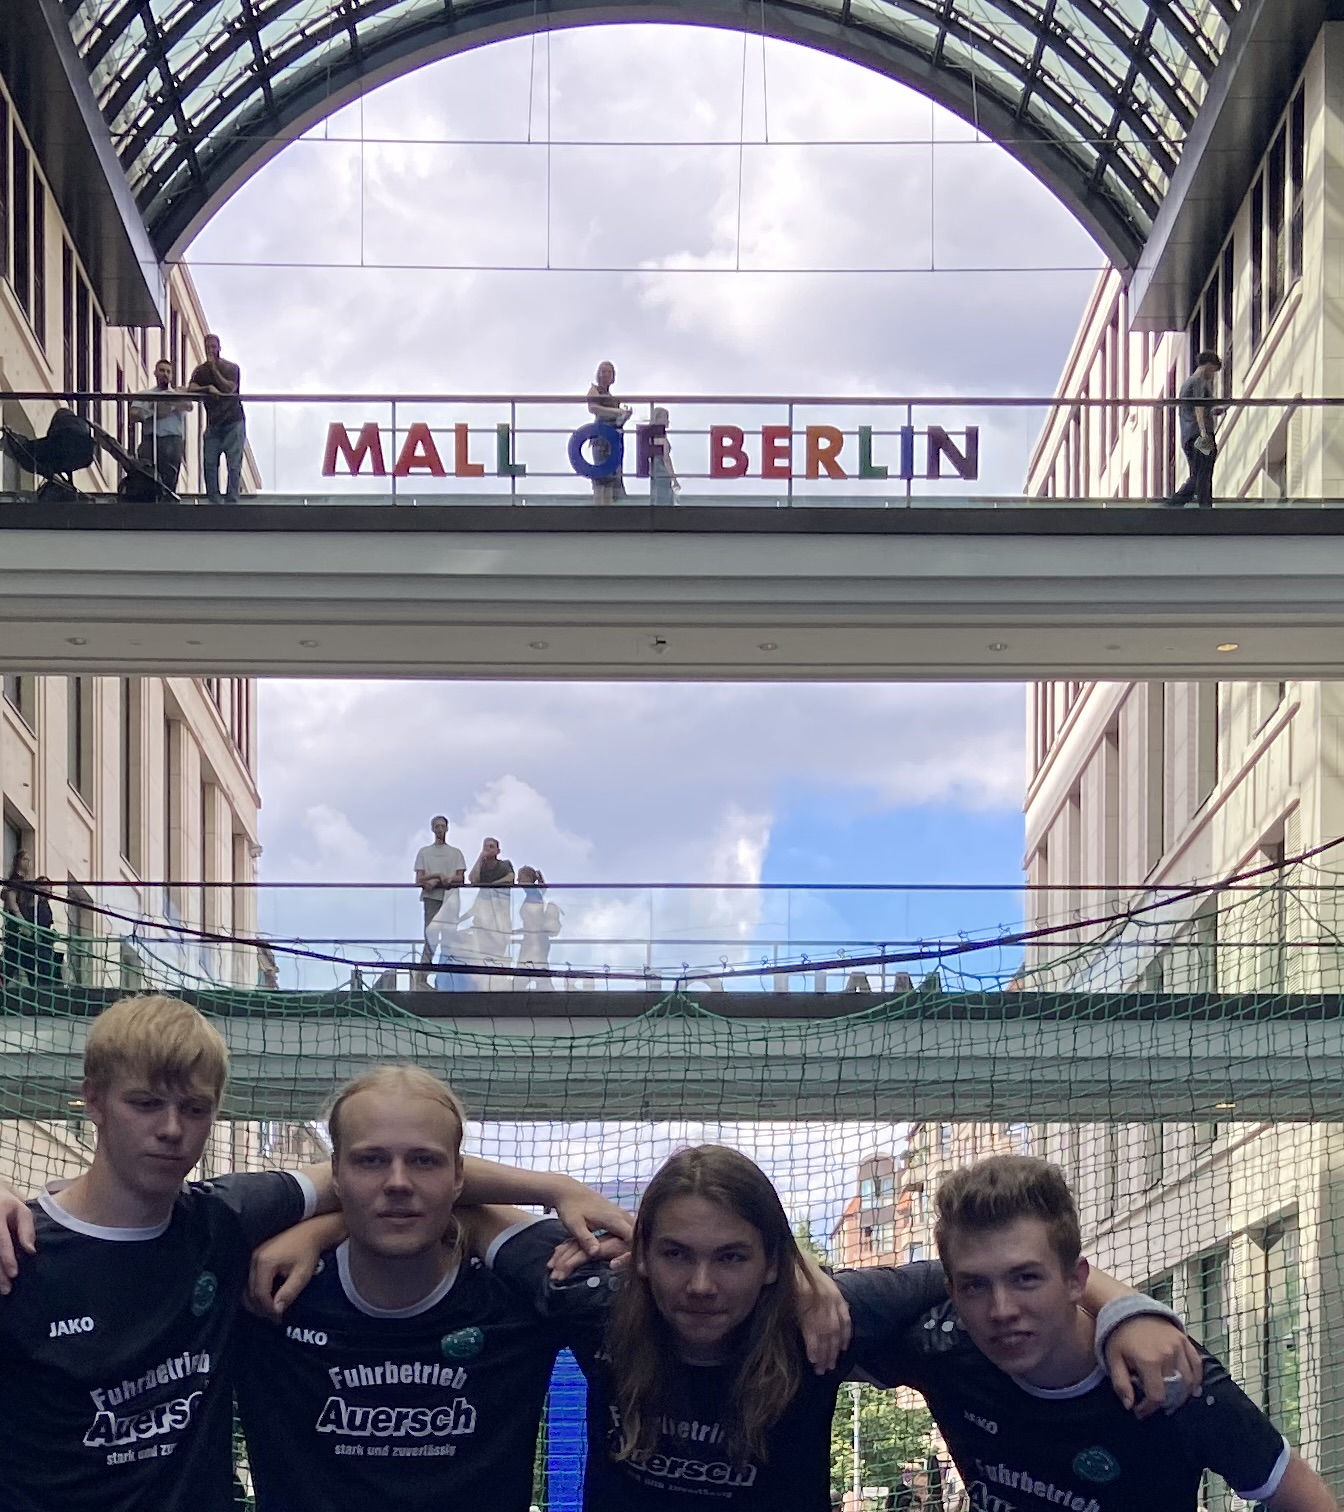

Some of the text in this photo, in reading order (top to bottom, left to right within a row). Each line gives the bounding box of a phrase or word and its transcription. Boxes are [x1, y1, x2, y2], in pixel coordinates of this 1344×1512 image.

[322, 422, 979, 480] MALL OF BERLIN
[49, 1316, 95, 1338] JAKO
[328, 1360, 468, 1390] Fuhrbetrieb
[315, 1396, 477, 1438] Auersch
[334, 1443, 364, 1456] stark
[367, 1444, 390, 1457] und
